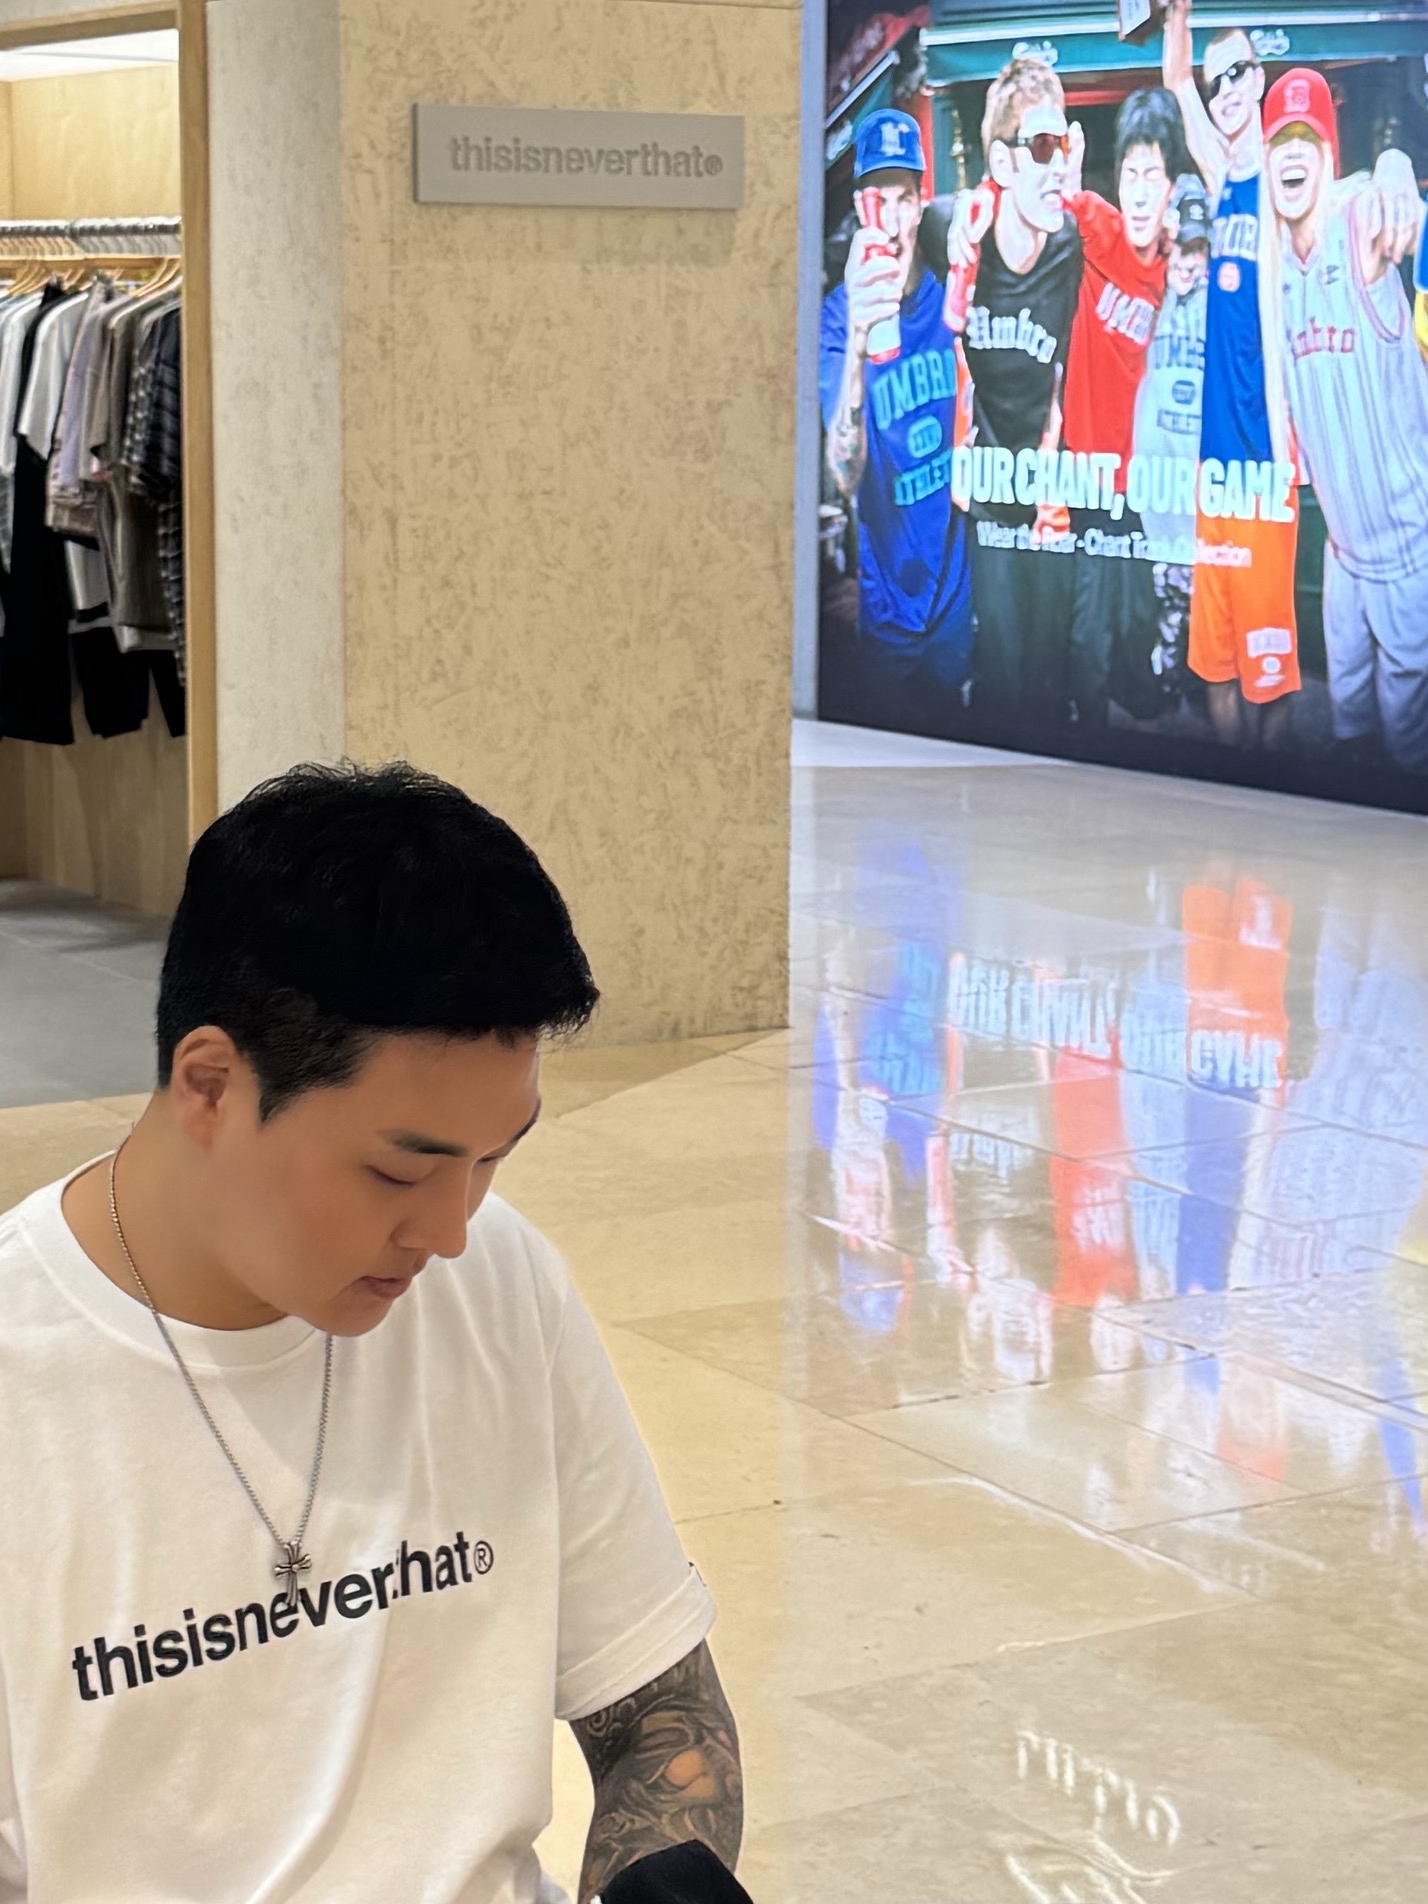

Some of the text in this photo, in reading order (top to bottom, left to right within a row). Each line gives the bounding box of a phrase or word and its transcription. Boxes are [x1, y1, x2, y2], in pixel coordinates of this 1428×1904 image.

[951, 445, 1015, 505] OUR
[1126, 454, 1196, 516] OUR
[1198, 457, 1296, 523] GAME
[71, 1530, 496, 1702] thisisneverhat®
